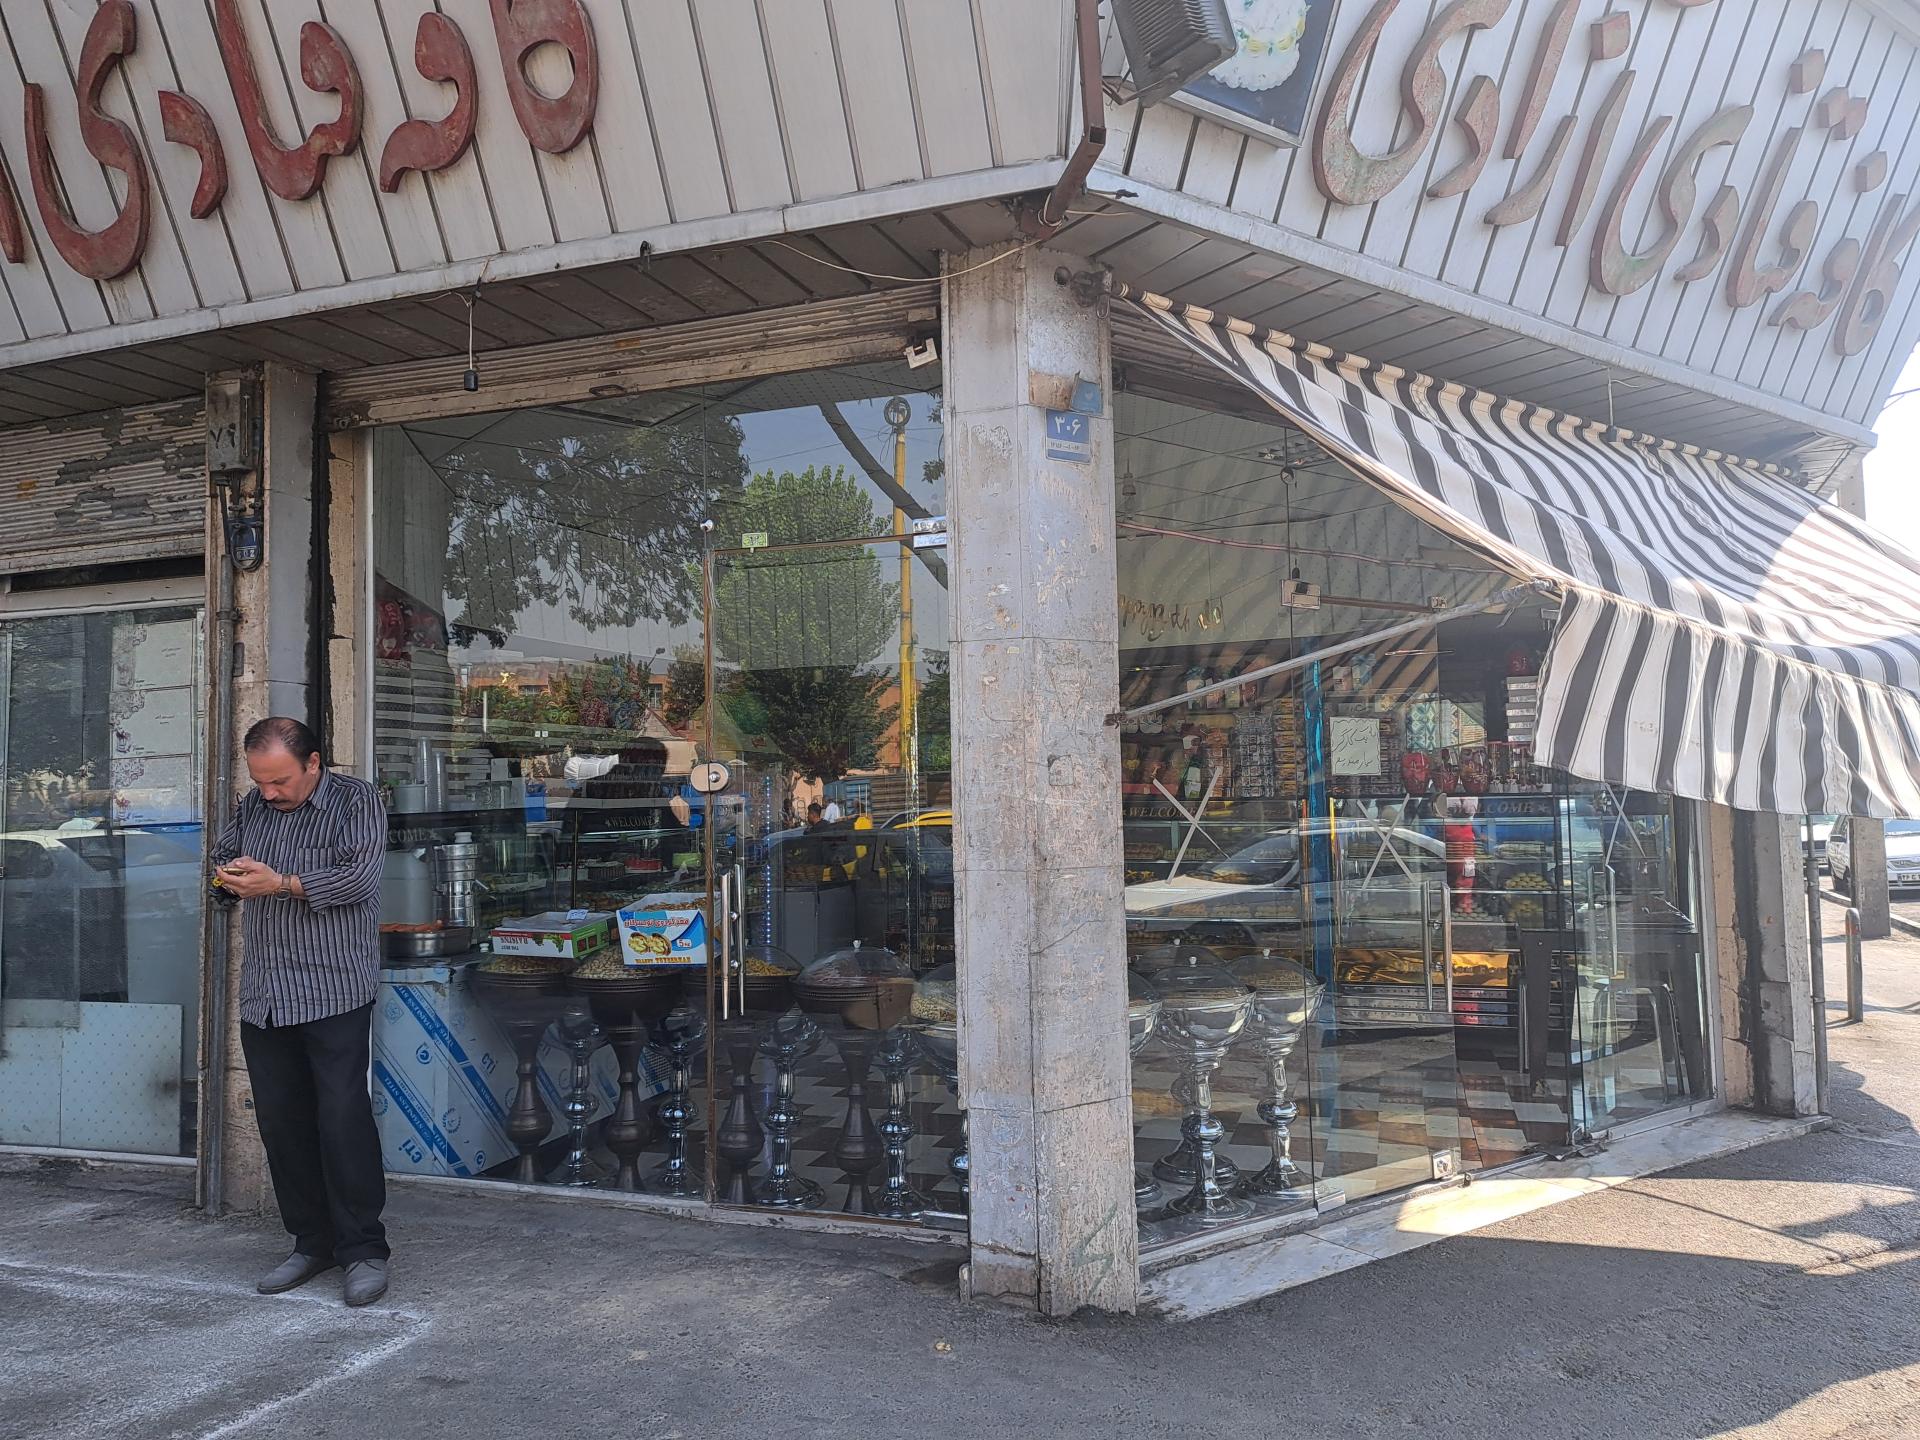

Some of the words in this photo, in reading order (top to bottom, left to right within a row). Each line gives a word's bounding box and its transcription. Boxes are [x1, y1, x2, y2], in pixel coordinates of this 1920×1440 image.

[1590, 50, 1867, 308] قنادی
[1055, 416, 1081, 436] ۳۰۶
[388, 827, 427, 843] COME
